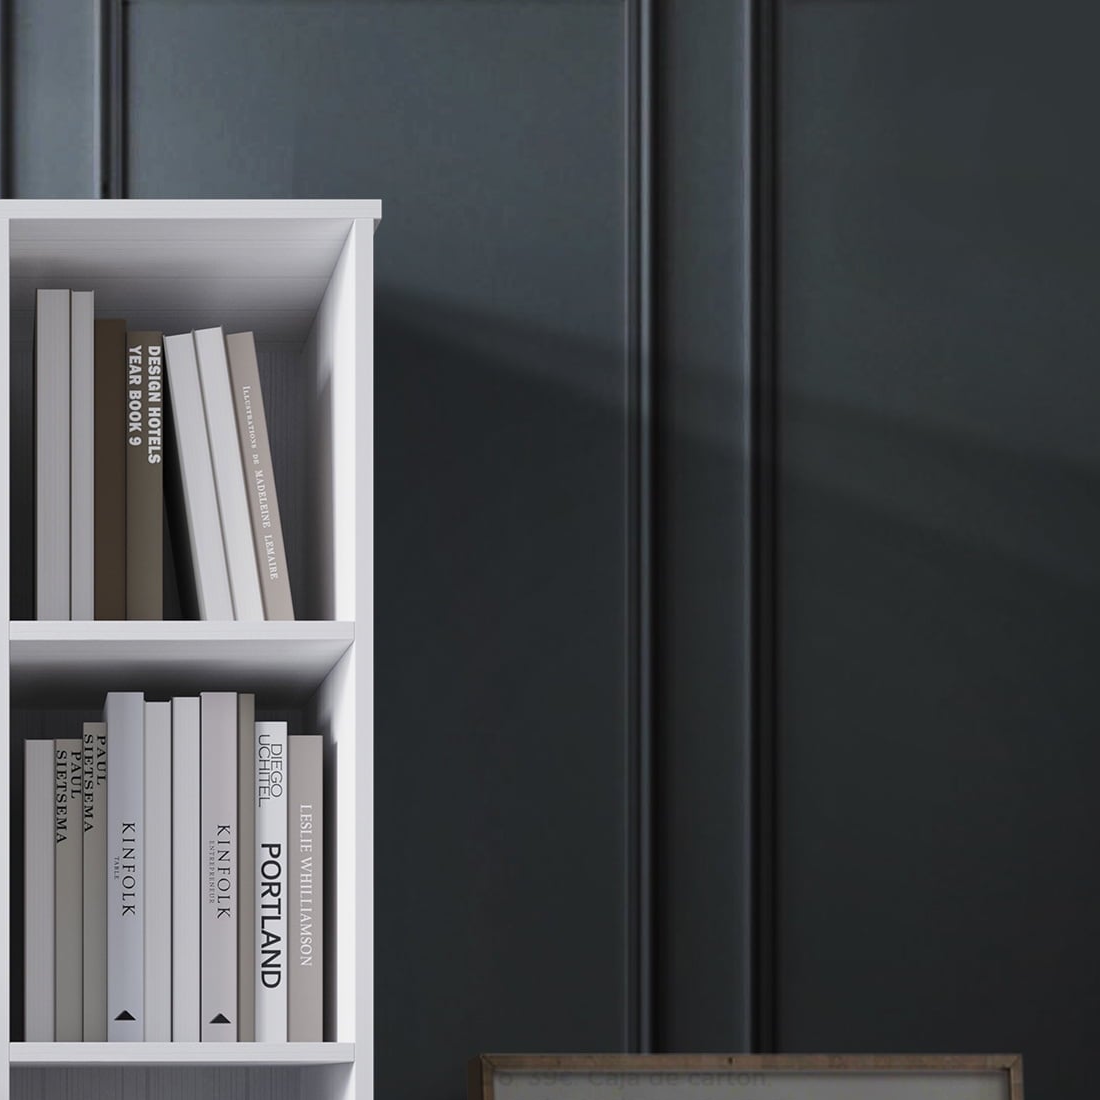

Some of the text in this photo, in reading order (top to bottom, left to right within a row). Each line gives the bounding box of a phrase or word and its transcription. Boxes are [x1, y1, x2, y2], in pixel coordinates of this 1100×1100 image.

[129, 345, 142, 446] YEAR BOOK 9
[147, 345, 161, 464] DESIGN HOTELS
[254, 469, 271, 528] MADELEINE
[264, 534, 279, 580] LEMAIRE
[56, 750, 68, 844] SIETSEMA
[71, 751, 82, 800] PAUL
[84, 733, 94, 833] SIETSEMA
[96, 735, 107, 786] PAUL
[258, 734, 270, 808] UCHITEL
[270, 743, 283, 799] DIEGO
[121, 821, 136, 917] KINFOLK
[216, 824, 231, 919] KINFOLK
[300, 803, 312, 853] LESLIE
[260, 843, 282, 990] PORTLAND
